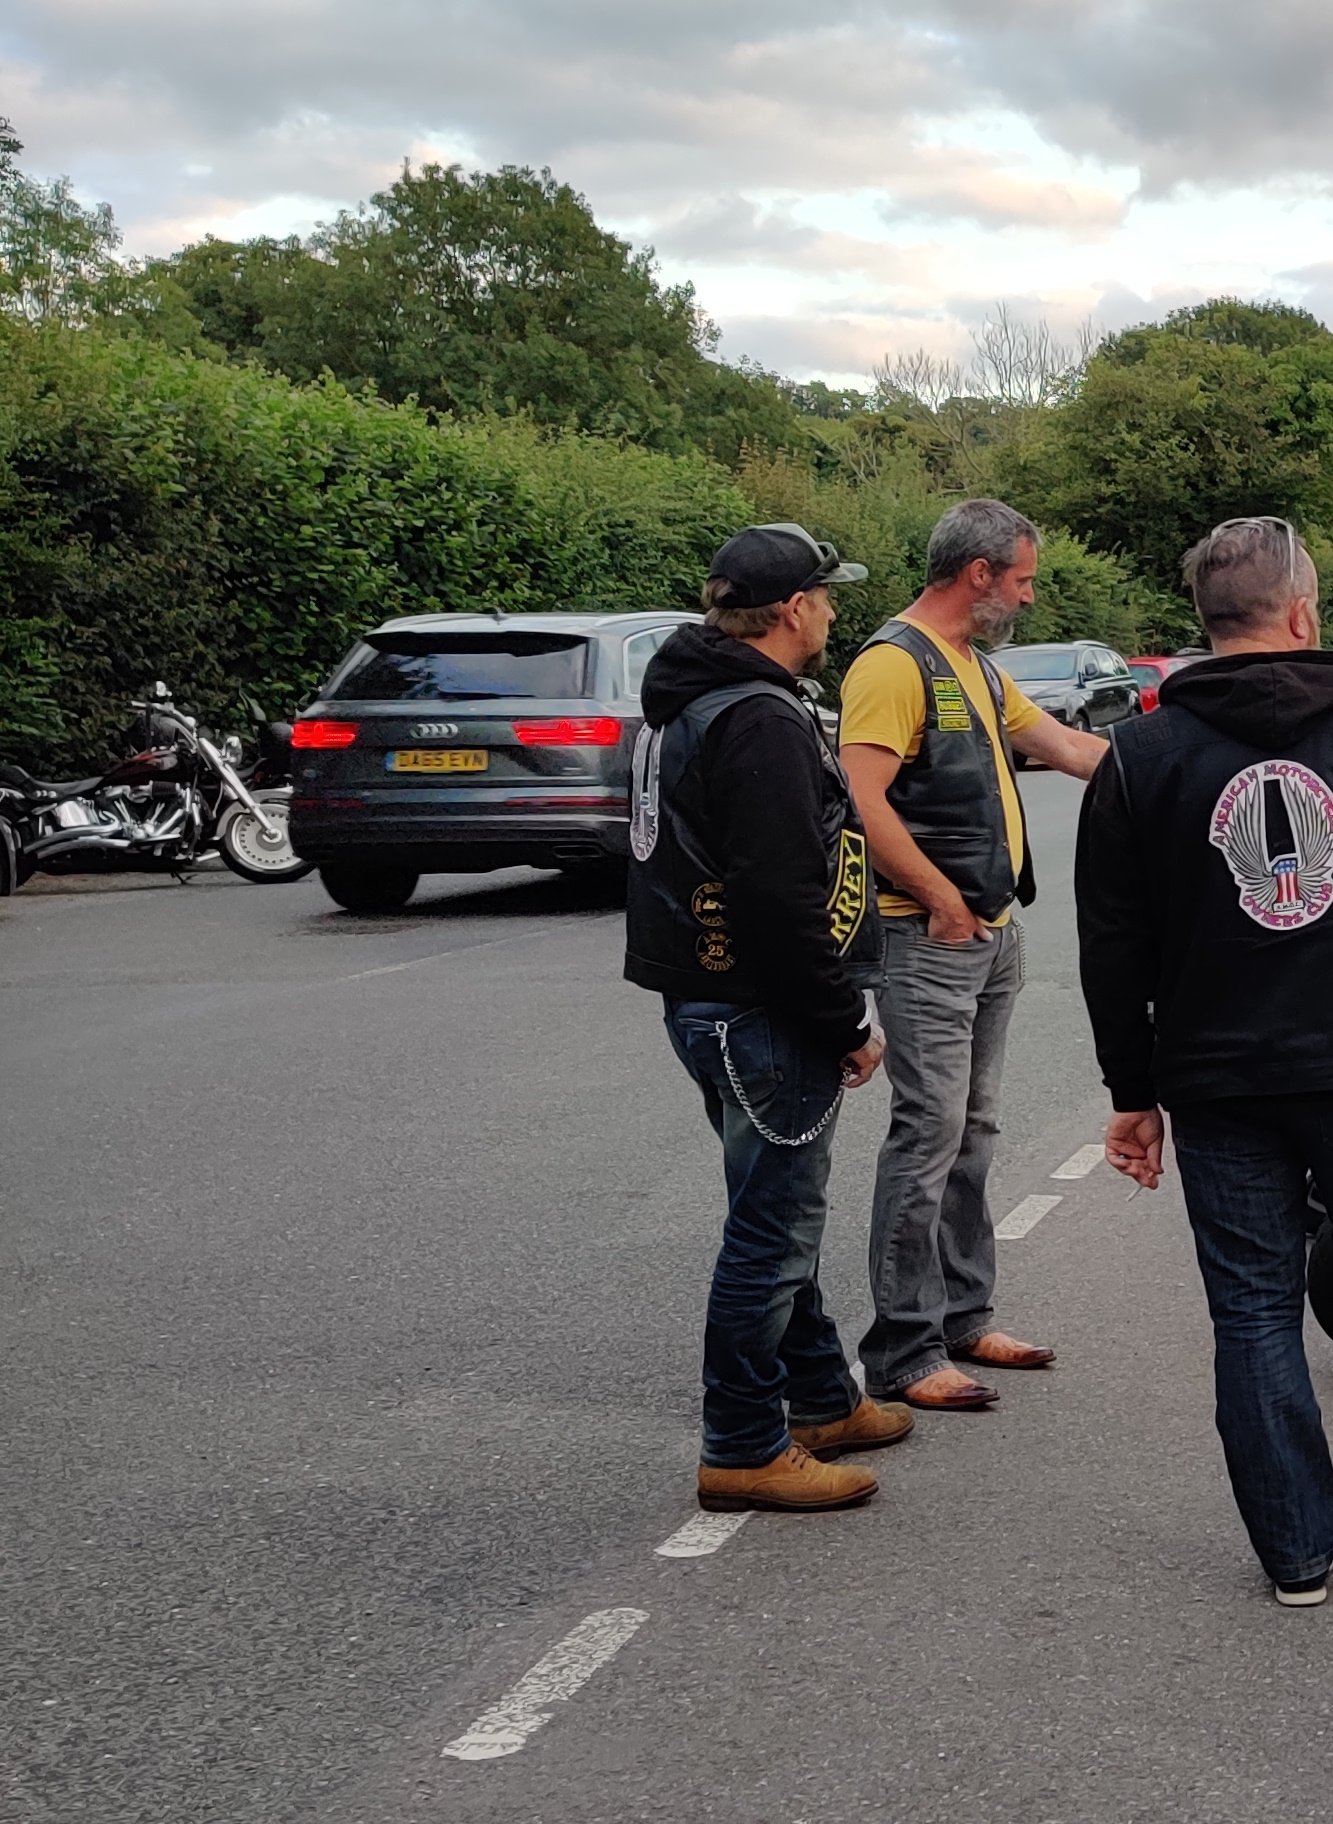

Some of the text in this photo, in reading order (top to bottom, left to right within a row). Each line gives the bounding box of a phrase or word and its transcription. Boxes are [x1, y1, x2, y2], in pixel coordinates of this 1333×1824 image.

[1212, 768, 1259, 846] AMERICAN
[830, 836, 863, 944] RREY
[1242, 883, 1333, 928] OWNERS CLUB
[707, 944, 724, 957] 25
